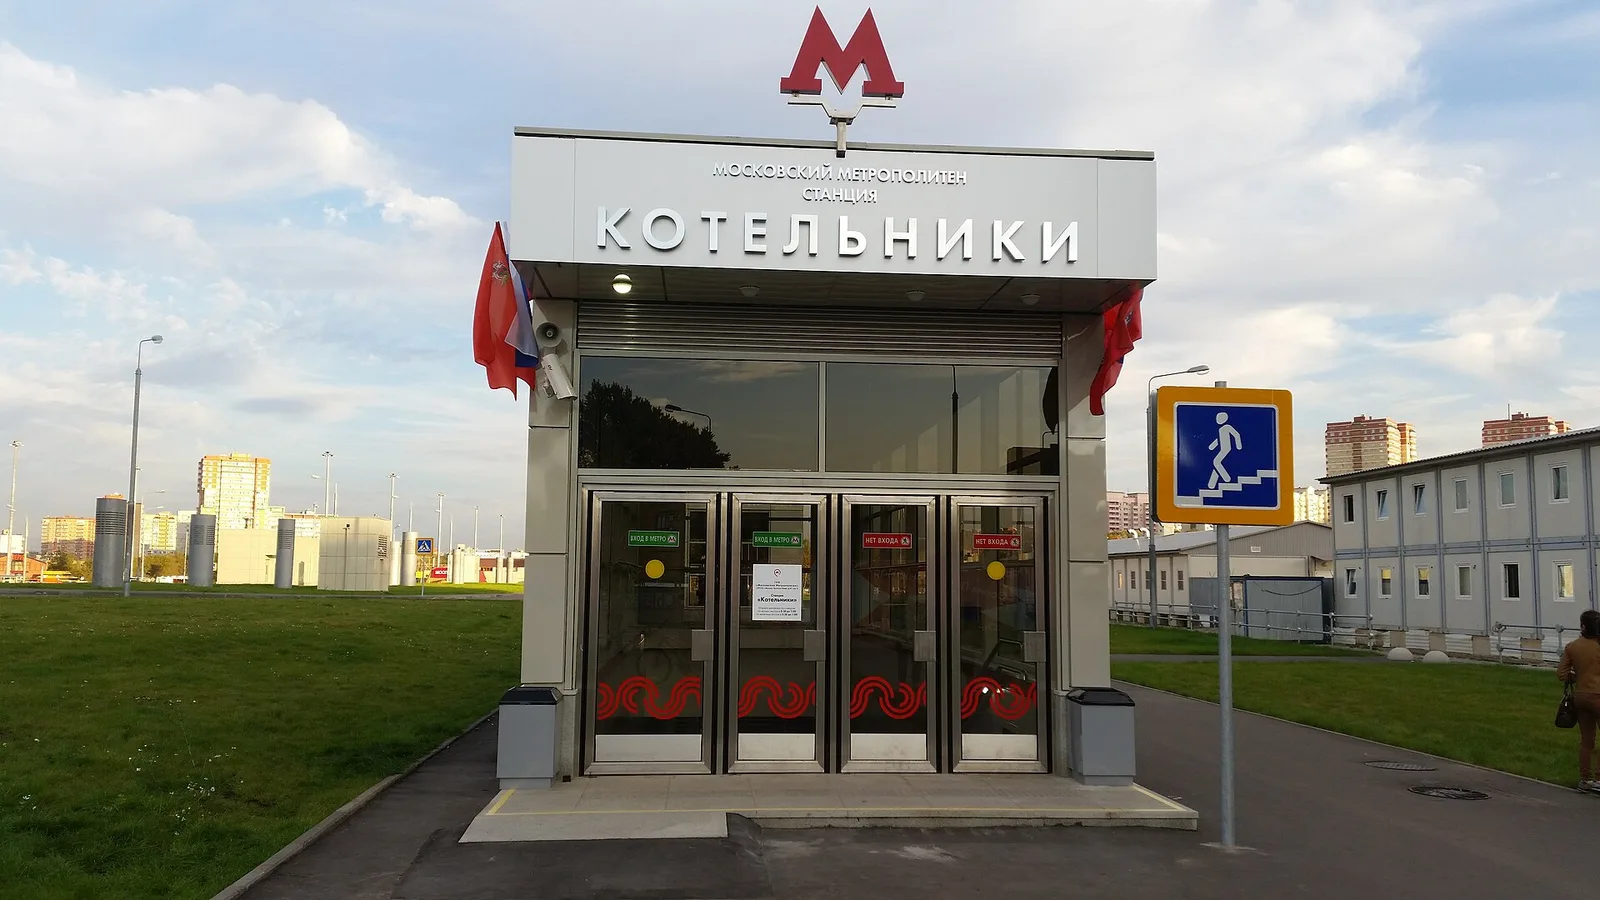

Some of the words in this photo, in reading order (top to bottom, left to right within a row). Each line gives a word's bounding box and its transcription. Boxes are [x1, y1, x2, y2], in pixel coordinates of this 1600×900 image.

[712, 161, 832, 181] МОСКОВСКИЙ
[836, 166, 968, 186] МЕТРОПОЛИТЕН
[802, 187, 878, 204] СТАНЦИЯ
[596, 206, 1079, 264] КОТЕЛЬНИКИ
[630, 535, 645, 543] ВХОД
[650, 535, 667, 543] МЕТРО
[754, 536, 769, 544] ВХОД
[773, 536, 790, 544] МЕТРО
[877, 537, 899, 545] ВХОДА
[987, 538, 1009, 546] ВХОДА
